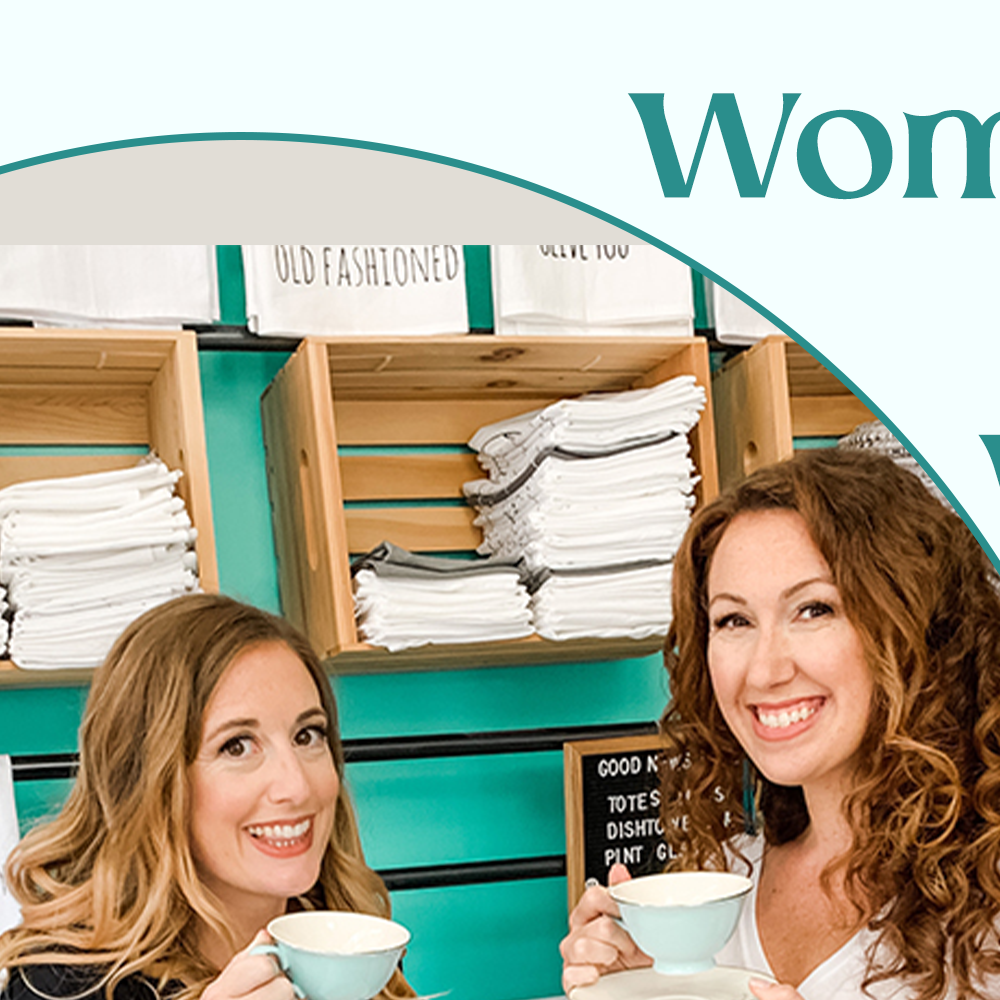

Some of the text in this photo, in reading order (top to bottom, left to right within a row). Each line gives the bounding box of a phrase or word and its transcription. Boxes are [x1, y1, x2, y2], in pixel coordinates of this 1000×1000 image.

[274, 245, 459, 287] OLD FASHIONED
[598, 755, 642, 778] GOOD
[607, 789, 661, 814] TOTES
[604, 845, 643, 867] PINT
